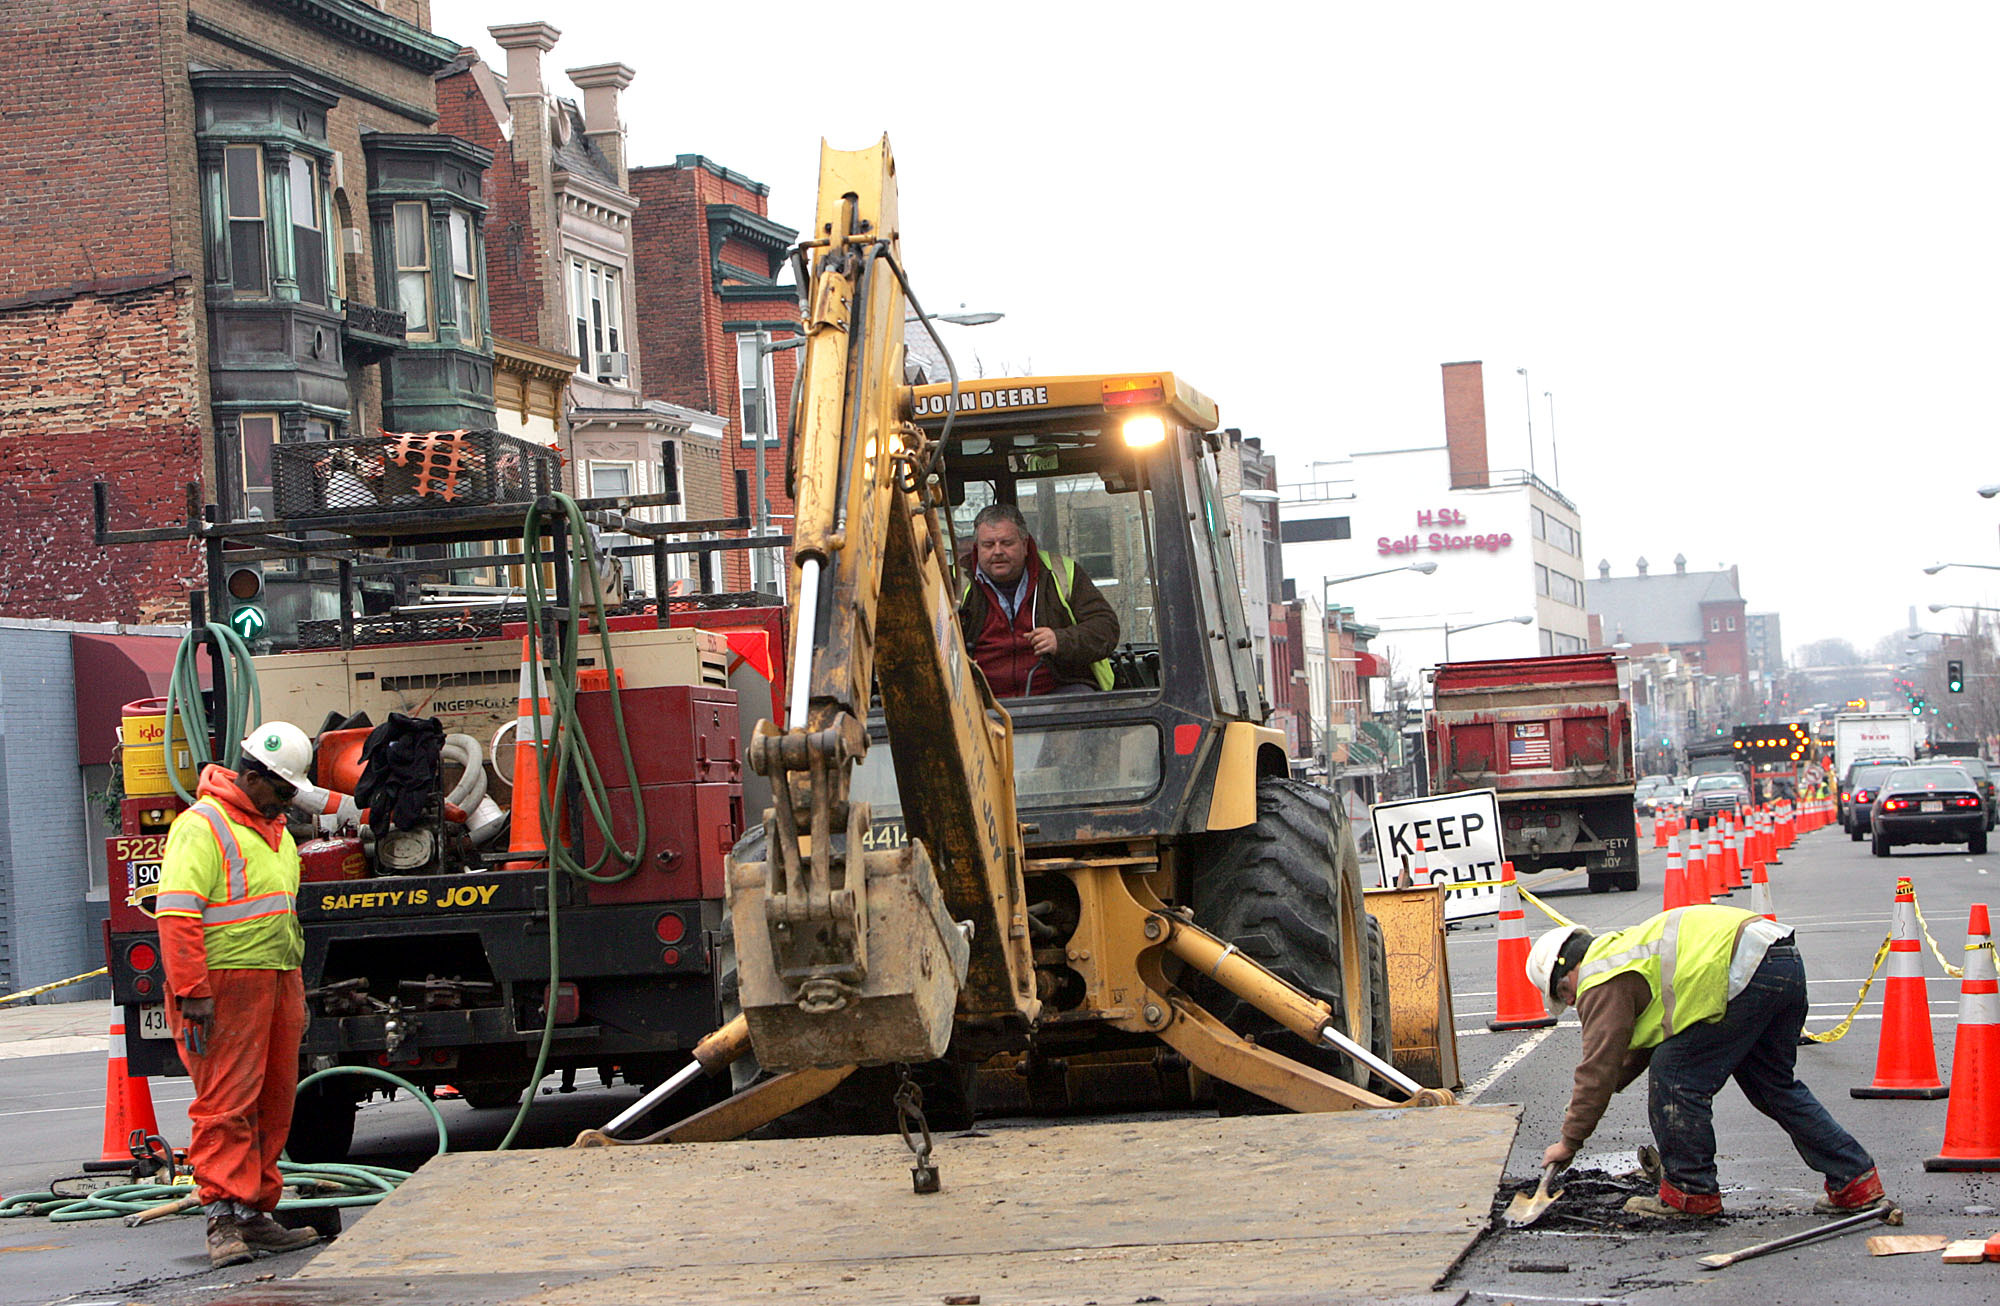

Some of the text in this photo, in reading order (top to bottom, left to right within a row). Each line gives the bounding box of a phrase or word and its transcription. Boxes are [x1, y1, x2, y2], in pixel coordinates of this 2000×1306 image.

[915, 386, 1049, 415] JOHN DEERE
[1417, 509, 1432, 527] H
[1377, 533, 1513, 555] Self Storage
[139, 723, 165, 742] iglo
[1388, 813, 1484, 858] KEEP
[1604, 838, 1629, 849] FETY
[1601, 857, 1621, 868] JOY
[1606, 849, 1616, 857] IS
[1392, 861, 1496, 901] GHT
[321, 885, 500, 910] SAFETY IS JOY
[145, 1011, 167, 1030] 43
[77, 1183, 97, 1191] STIHL
